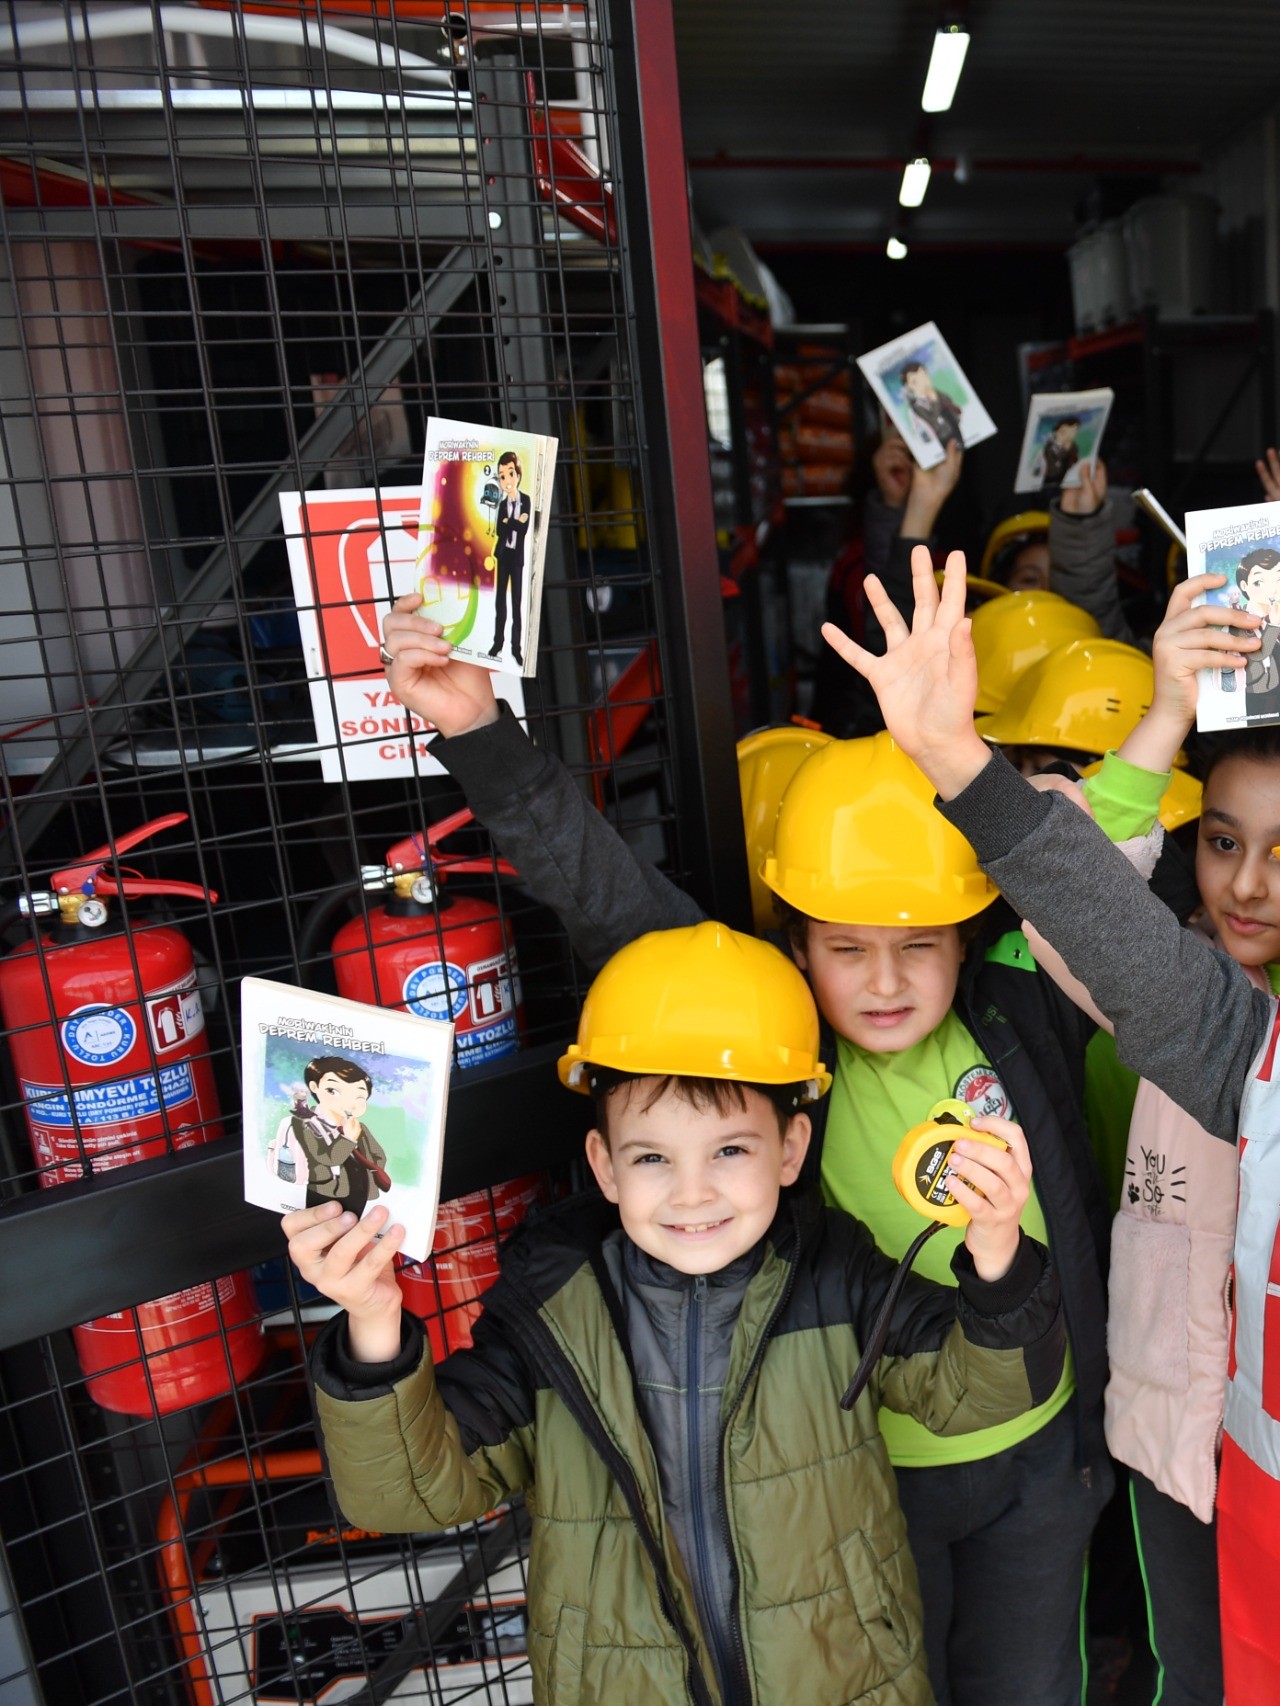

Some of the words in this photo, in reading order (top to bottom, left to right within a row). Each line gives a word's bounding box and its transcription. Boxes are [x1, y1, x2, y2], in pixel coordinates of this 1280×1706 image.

[428, 450, 460, 461] DEPREM
[1199, 534, 1244, 553] DEPREM
[363, 691, 401, 707] YA
[258, 1022, 318, 1044] DEPREM
[322, 1033, 386, 1055] REHBERİ
[476, 1020, 515, 1042] TOZLU
[72, 1044, 106, 1061] TOZLU
[110, 1033, 131, 1058] KURU
[68, 1092, 147, 1111] ÖNDÜRME
[150, 1076, 189, 1097] CHAZI
